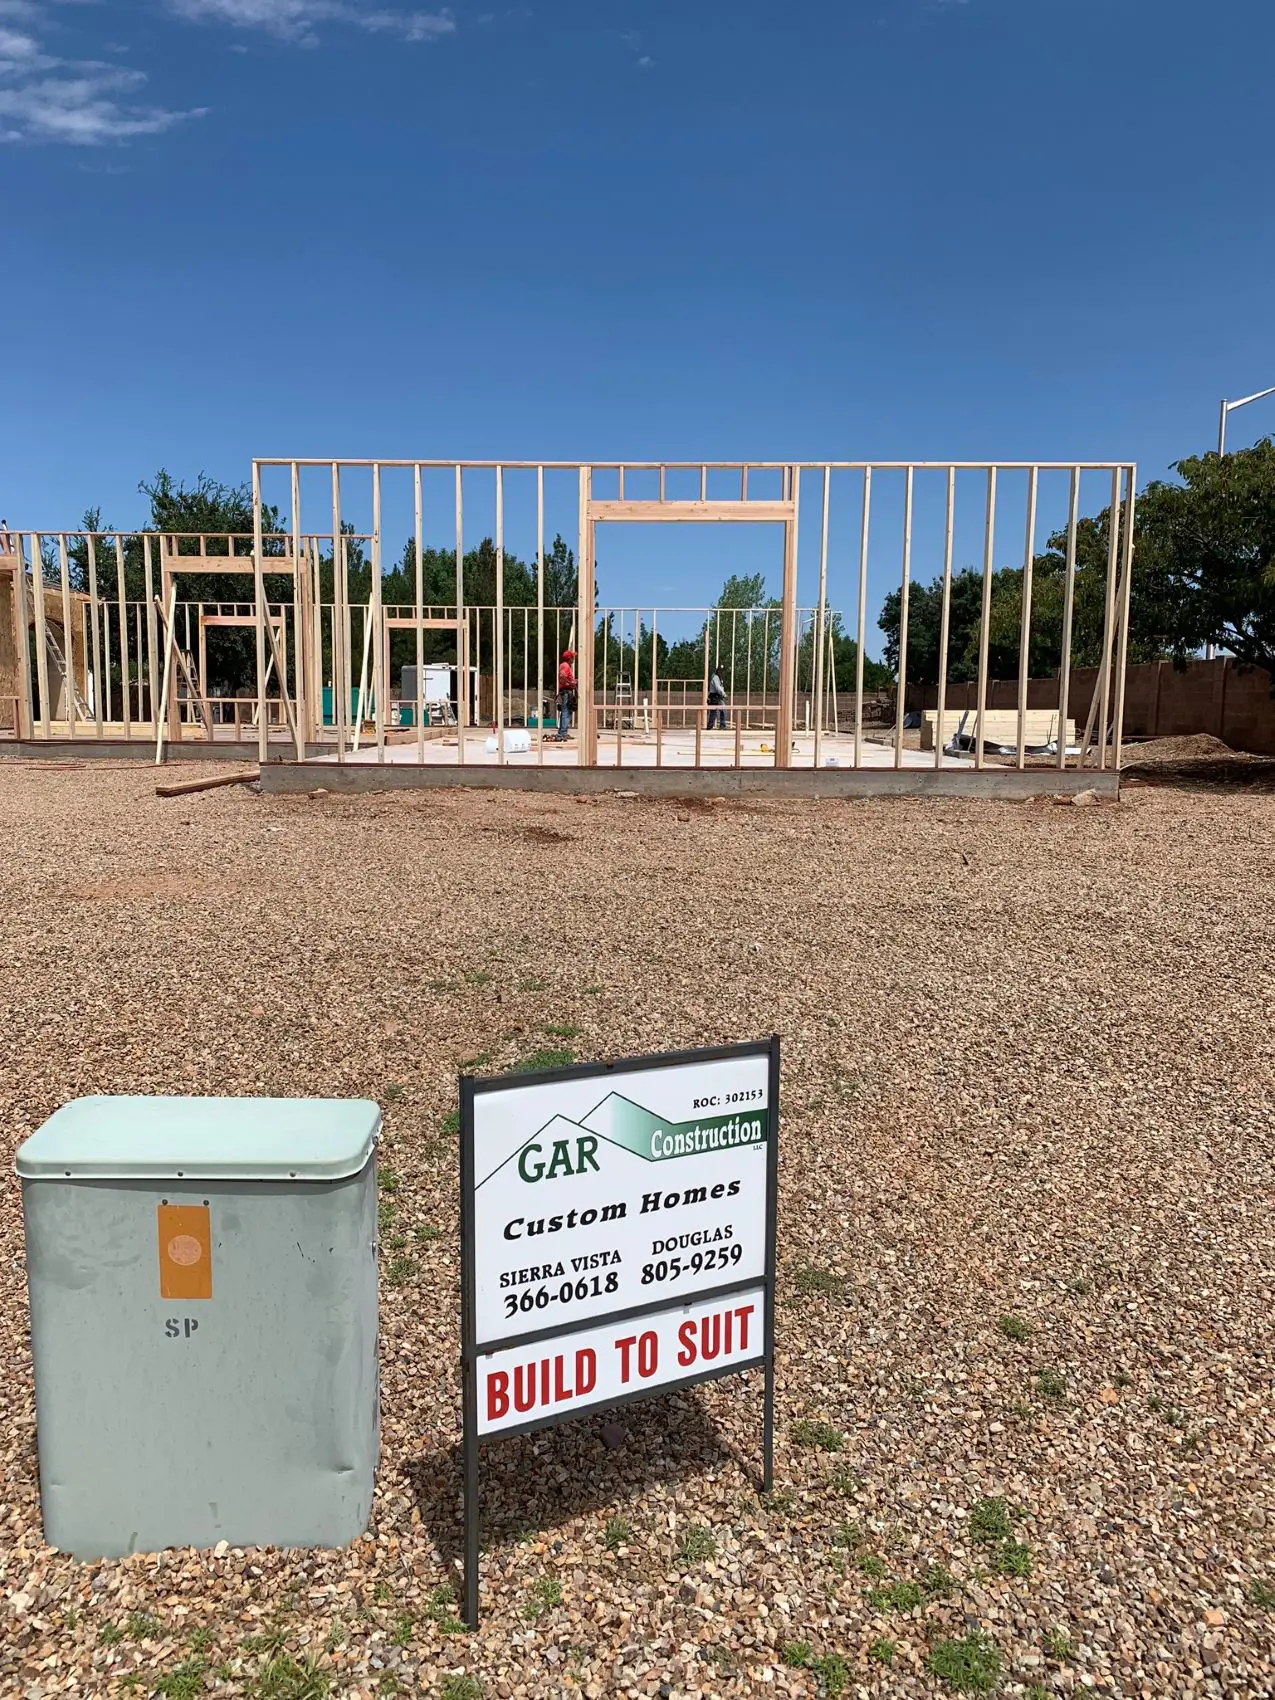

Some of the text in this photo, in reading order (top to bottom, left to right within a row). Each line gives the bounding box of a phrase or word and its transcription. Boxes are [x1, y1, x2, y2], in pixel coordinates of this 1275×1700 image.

[693, 1089, 763, 1109] ROC: 302153
[516, 1116, 762, 1184] GAR Construction
[503, 1179, 741, 1240] Custom Homes
[652, 1225, 733, 1255] DOUGLAS
[499, 1250, 622, 1288] SIERRA VISTA
[641, 1243, 743, 1285] 805-9259
[504, 1272, 619, 1319] 366-0618
[164, 1318, 199, 1338] SP
[487, 1305, 754, 1422] BUILD TO SUIT
